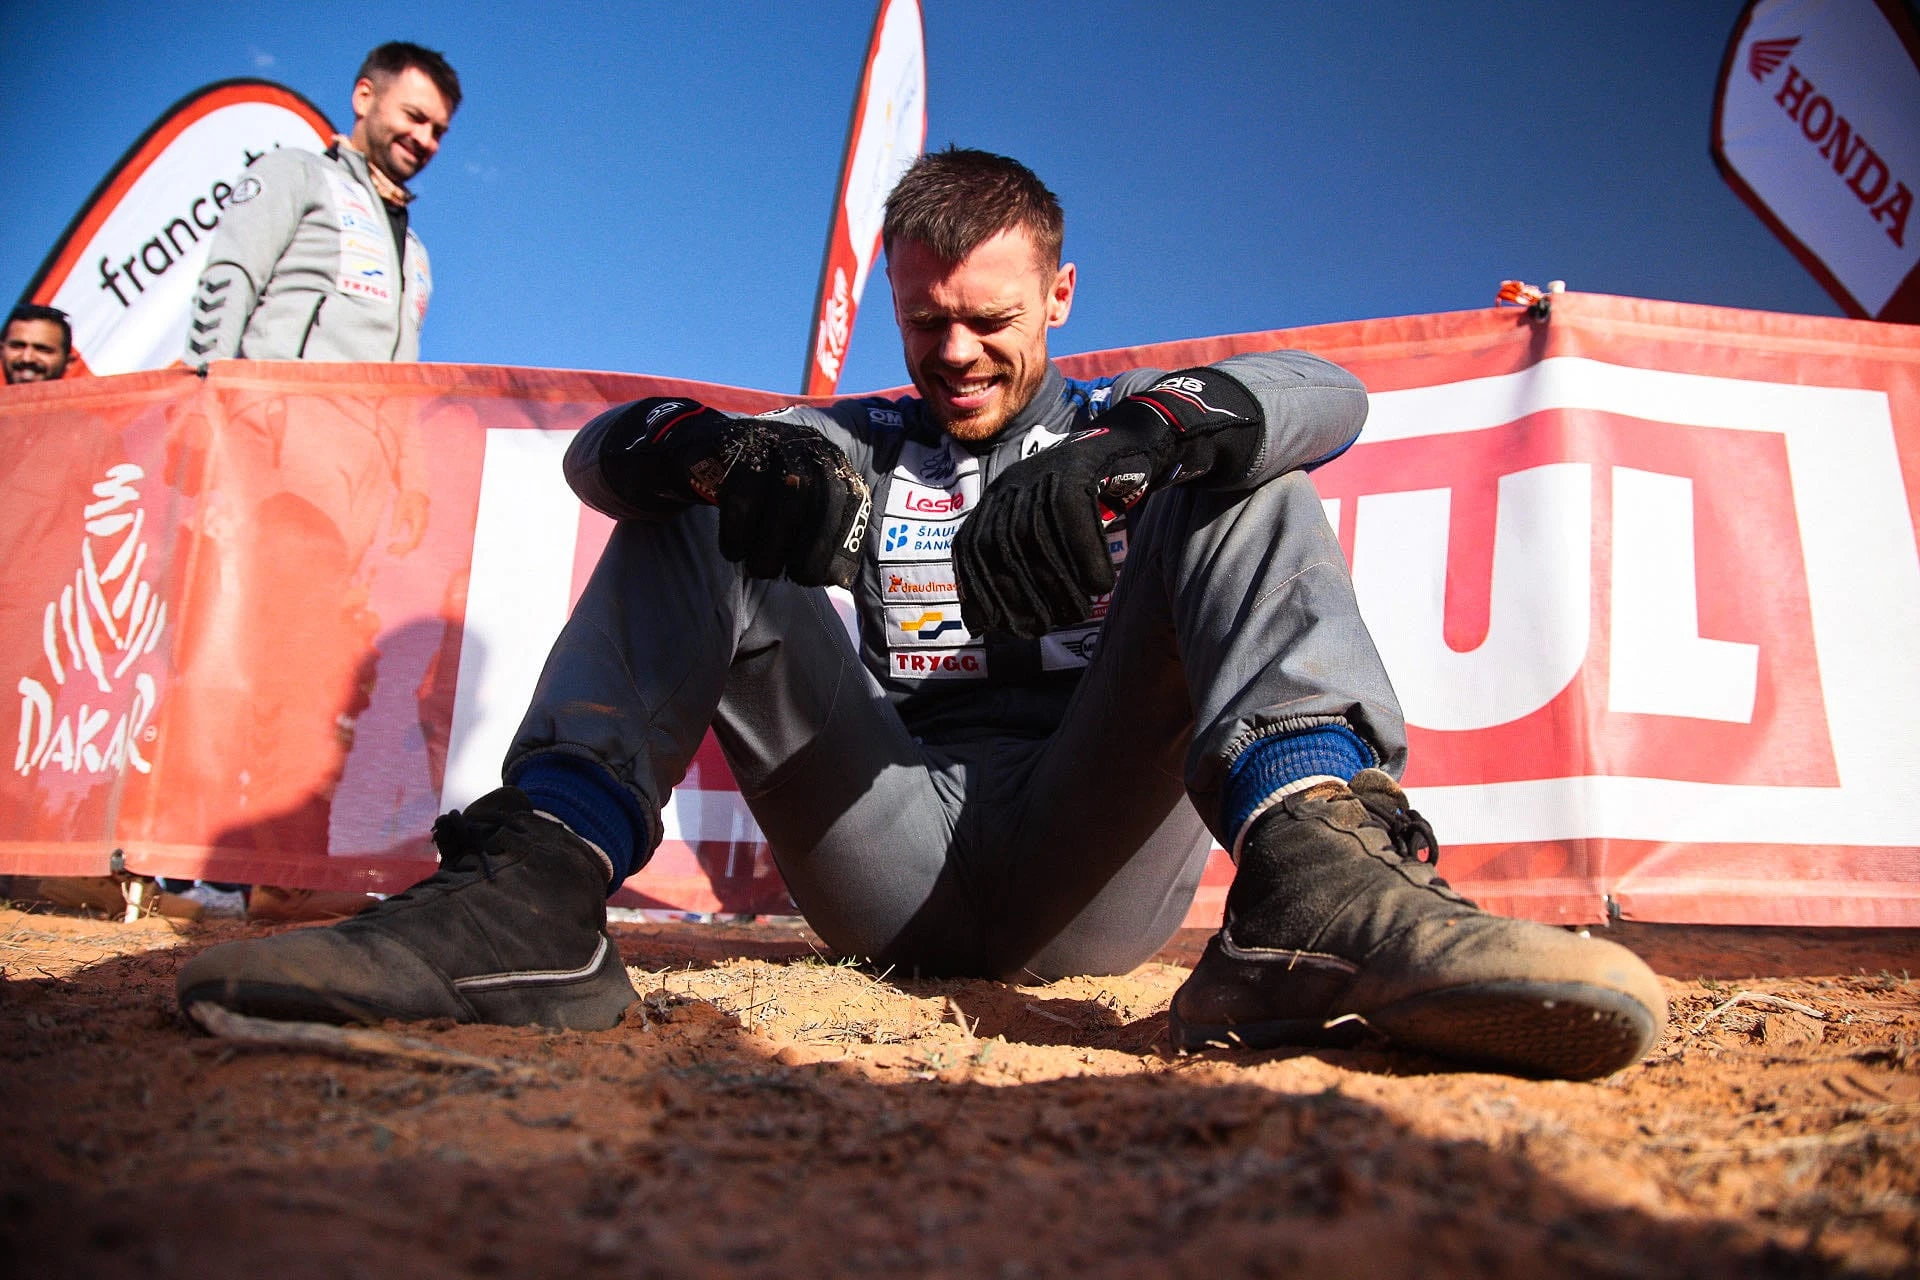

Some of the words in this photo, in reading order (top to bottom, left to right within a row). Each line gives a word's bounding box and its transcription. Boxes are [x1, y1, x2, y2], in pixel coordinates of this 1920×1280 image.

[1774, 64, 1914, 250] HONDA
[917, 525, 956, 537] ŠIAUL
[914, 540, 953, 552] BANK
[901, 581, 957, 593] draudima
[896, 654, 979, 672] TRYGG
[14, 673, 156, 776] DAKAR
